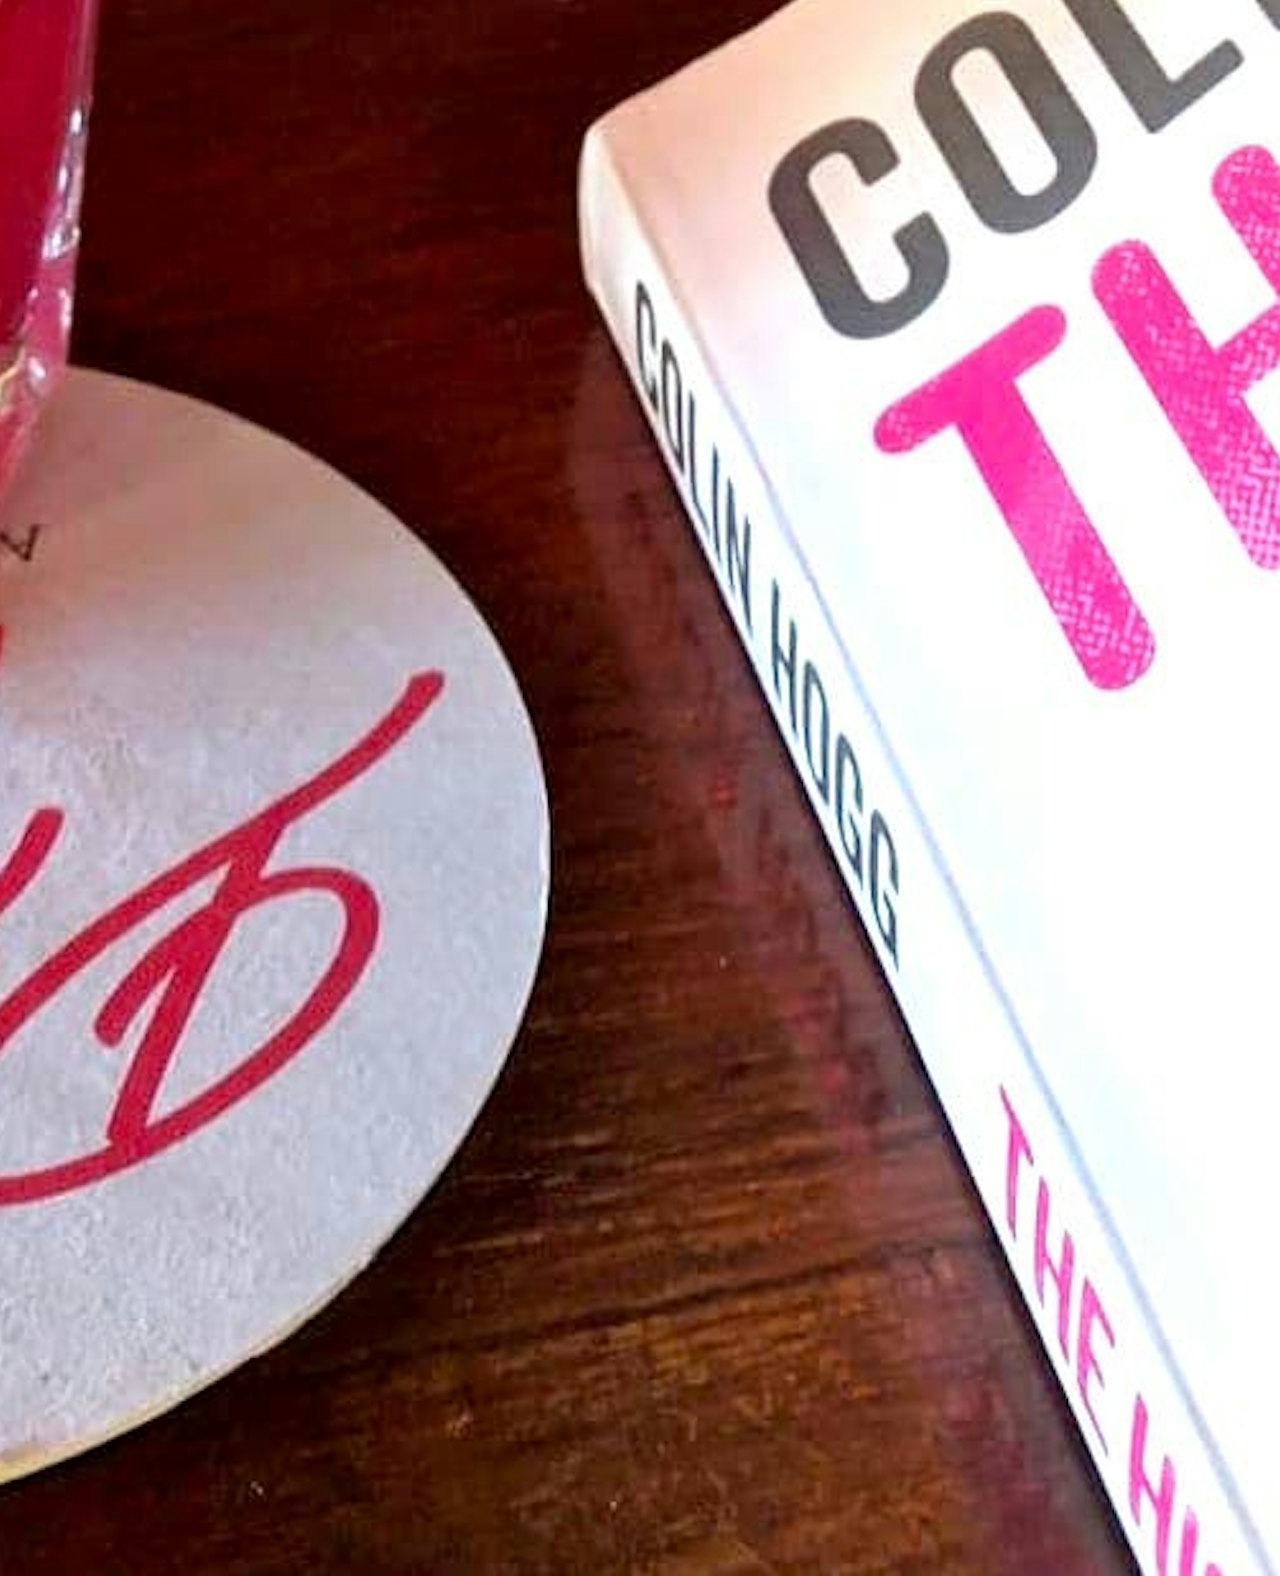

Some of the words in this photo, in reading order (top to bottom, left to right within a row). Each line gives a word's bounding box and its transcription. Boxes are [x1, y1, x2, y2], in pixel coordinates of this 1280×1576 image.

[634, 280, 754, 638] COLIN
[770, 577, 900, 973] HOGG
[998, 1082, 1116, 1458] THE
[1128, 1391, 1225, 1576] HI
